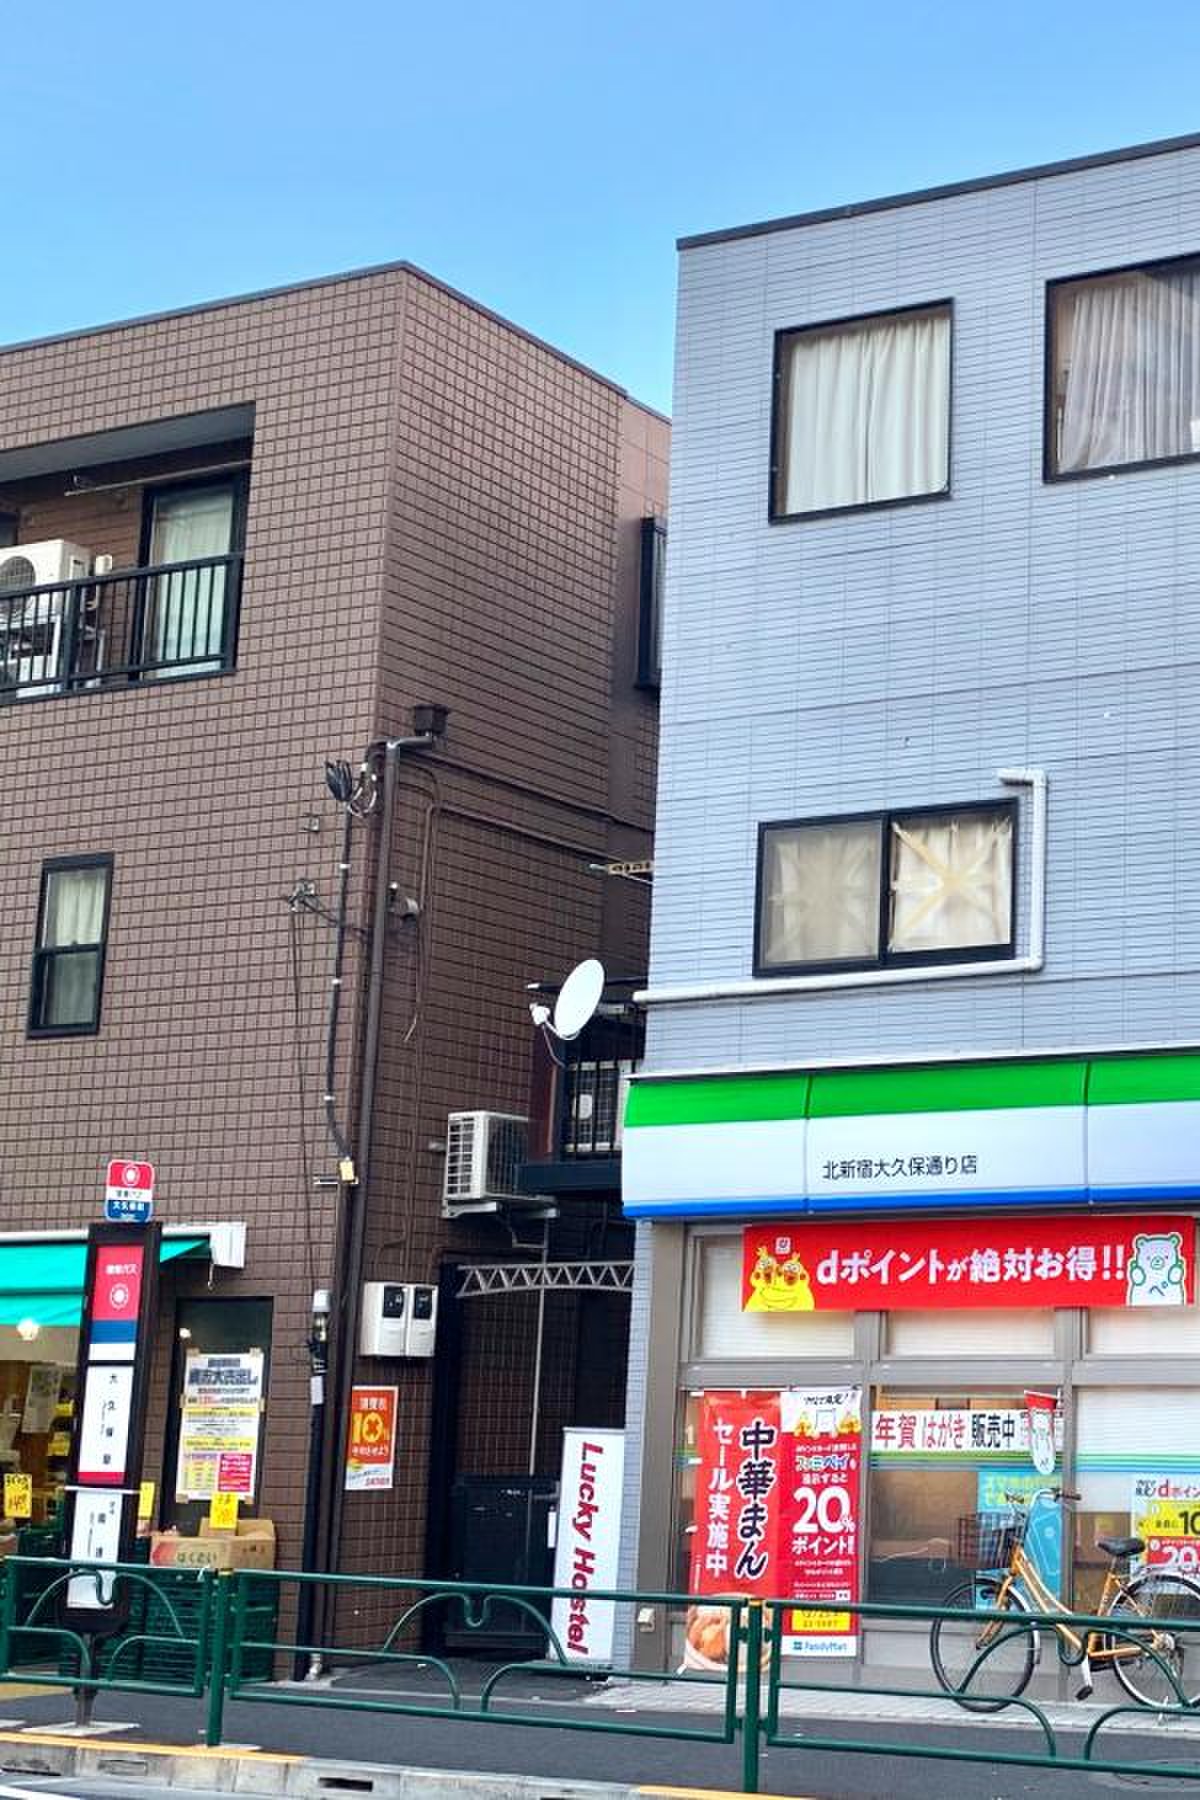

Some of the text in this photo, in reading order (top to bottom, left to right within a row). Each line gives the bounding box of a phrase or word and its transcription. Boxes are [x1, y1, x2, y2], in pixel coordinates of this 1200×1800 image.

[822, 1153, 978, 1181] 北新宿大久保通り店
[705, 1417, 734, 1578] セール実施中
[736, 1420, 775, 1578] 中華まん
[875, 1414, 917, 1449] 年賀
[922, 1413, 967, 1449] はがき
[971, 1413, 1016, 1448] 販売中
[567, 1441, 604, 1655] Lucky Hostel
